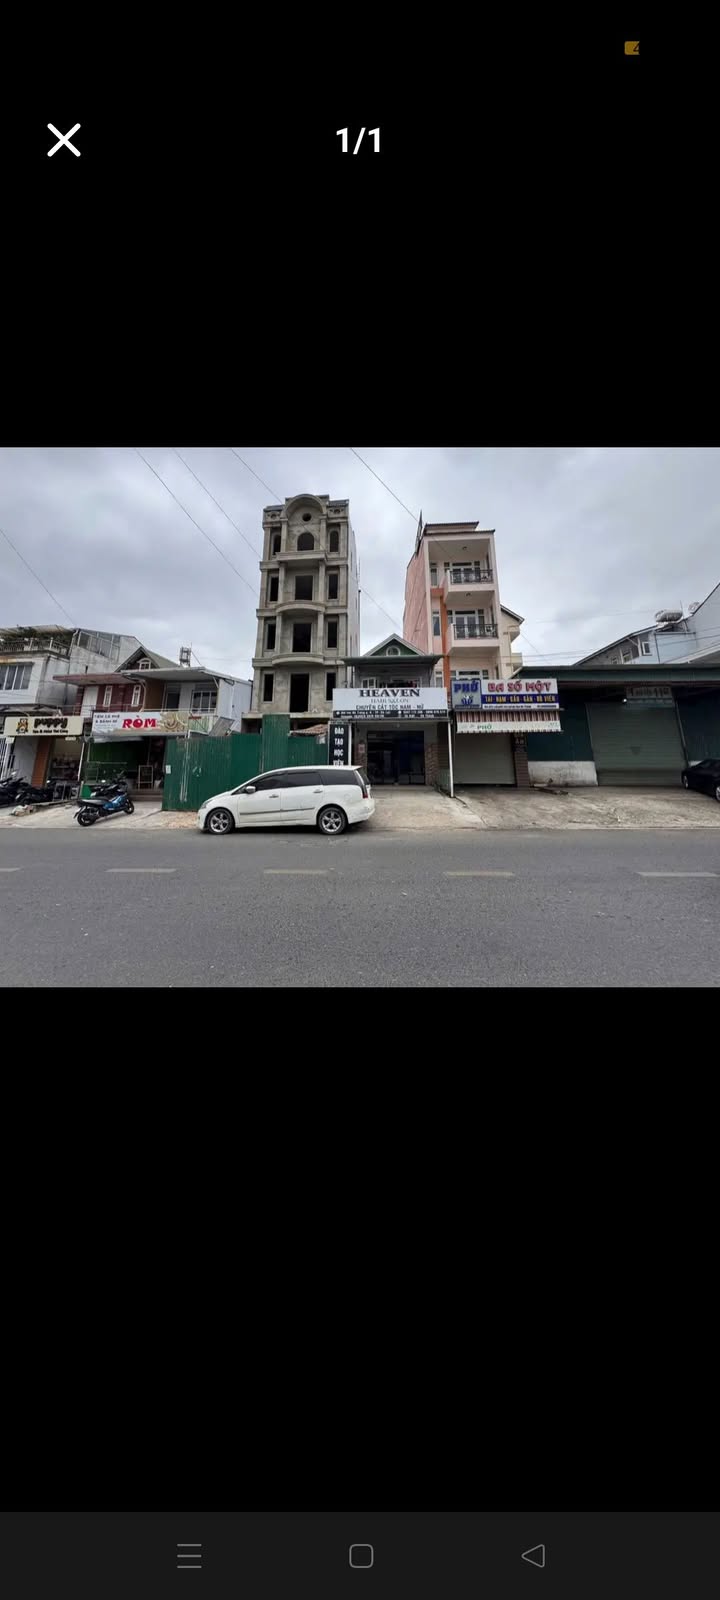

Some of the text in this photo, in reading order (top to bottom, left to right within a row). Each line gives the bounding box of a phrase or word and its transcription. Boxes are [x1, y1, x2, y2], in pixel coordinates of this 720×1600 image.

[507, 680, 522, 692] SỐ
[525, 680, 551, 694] MỘT
[359, 689, 420, 697] HEAVEN
[333, 749, 344, 757] HỌC
